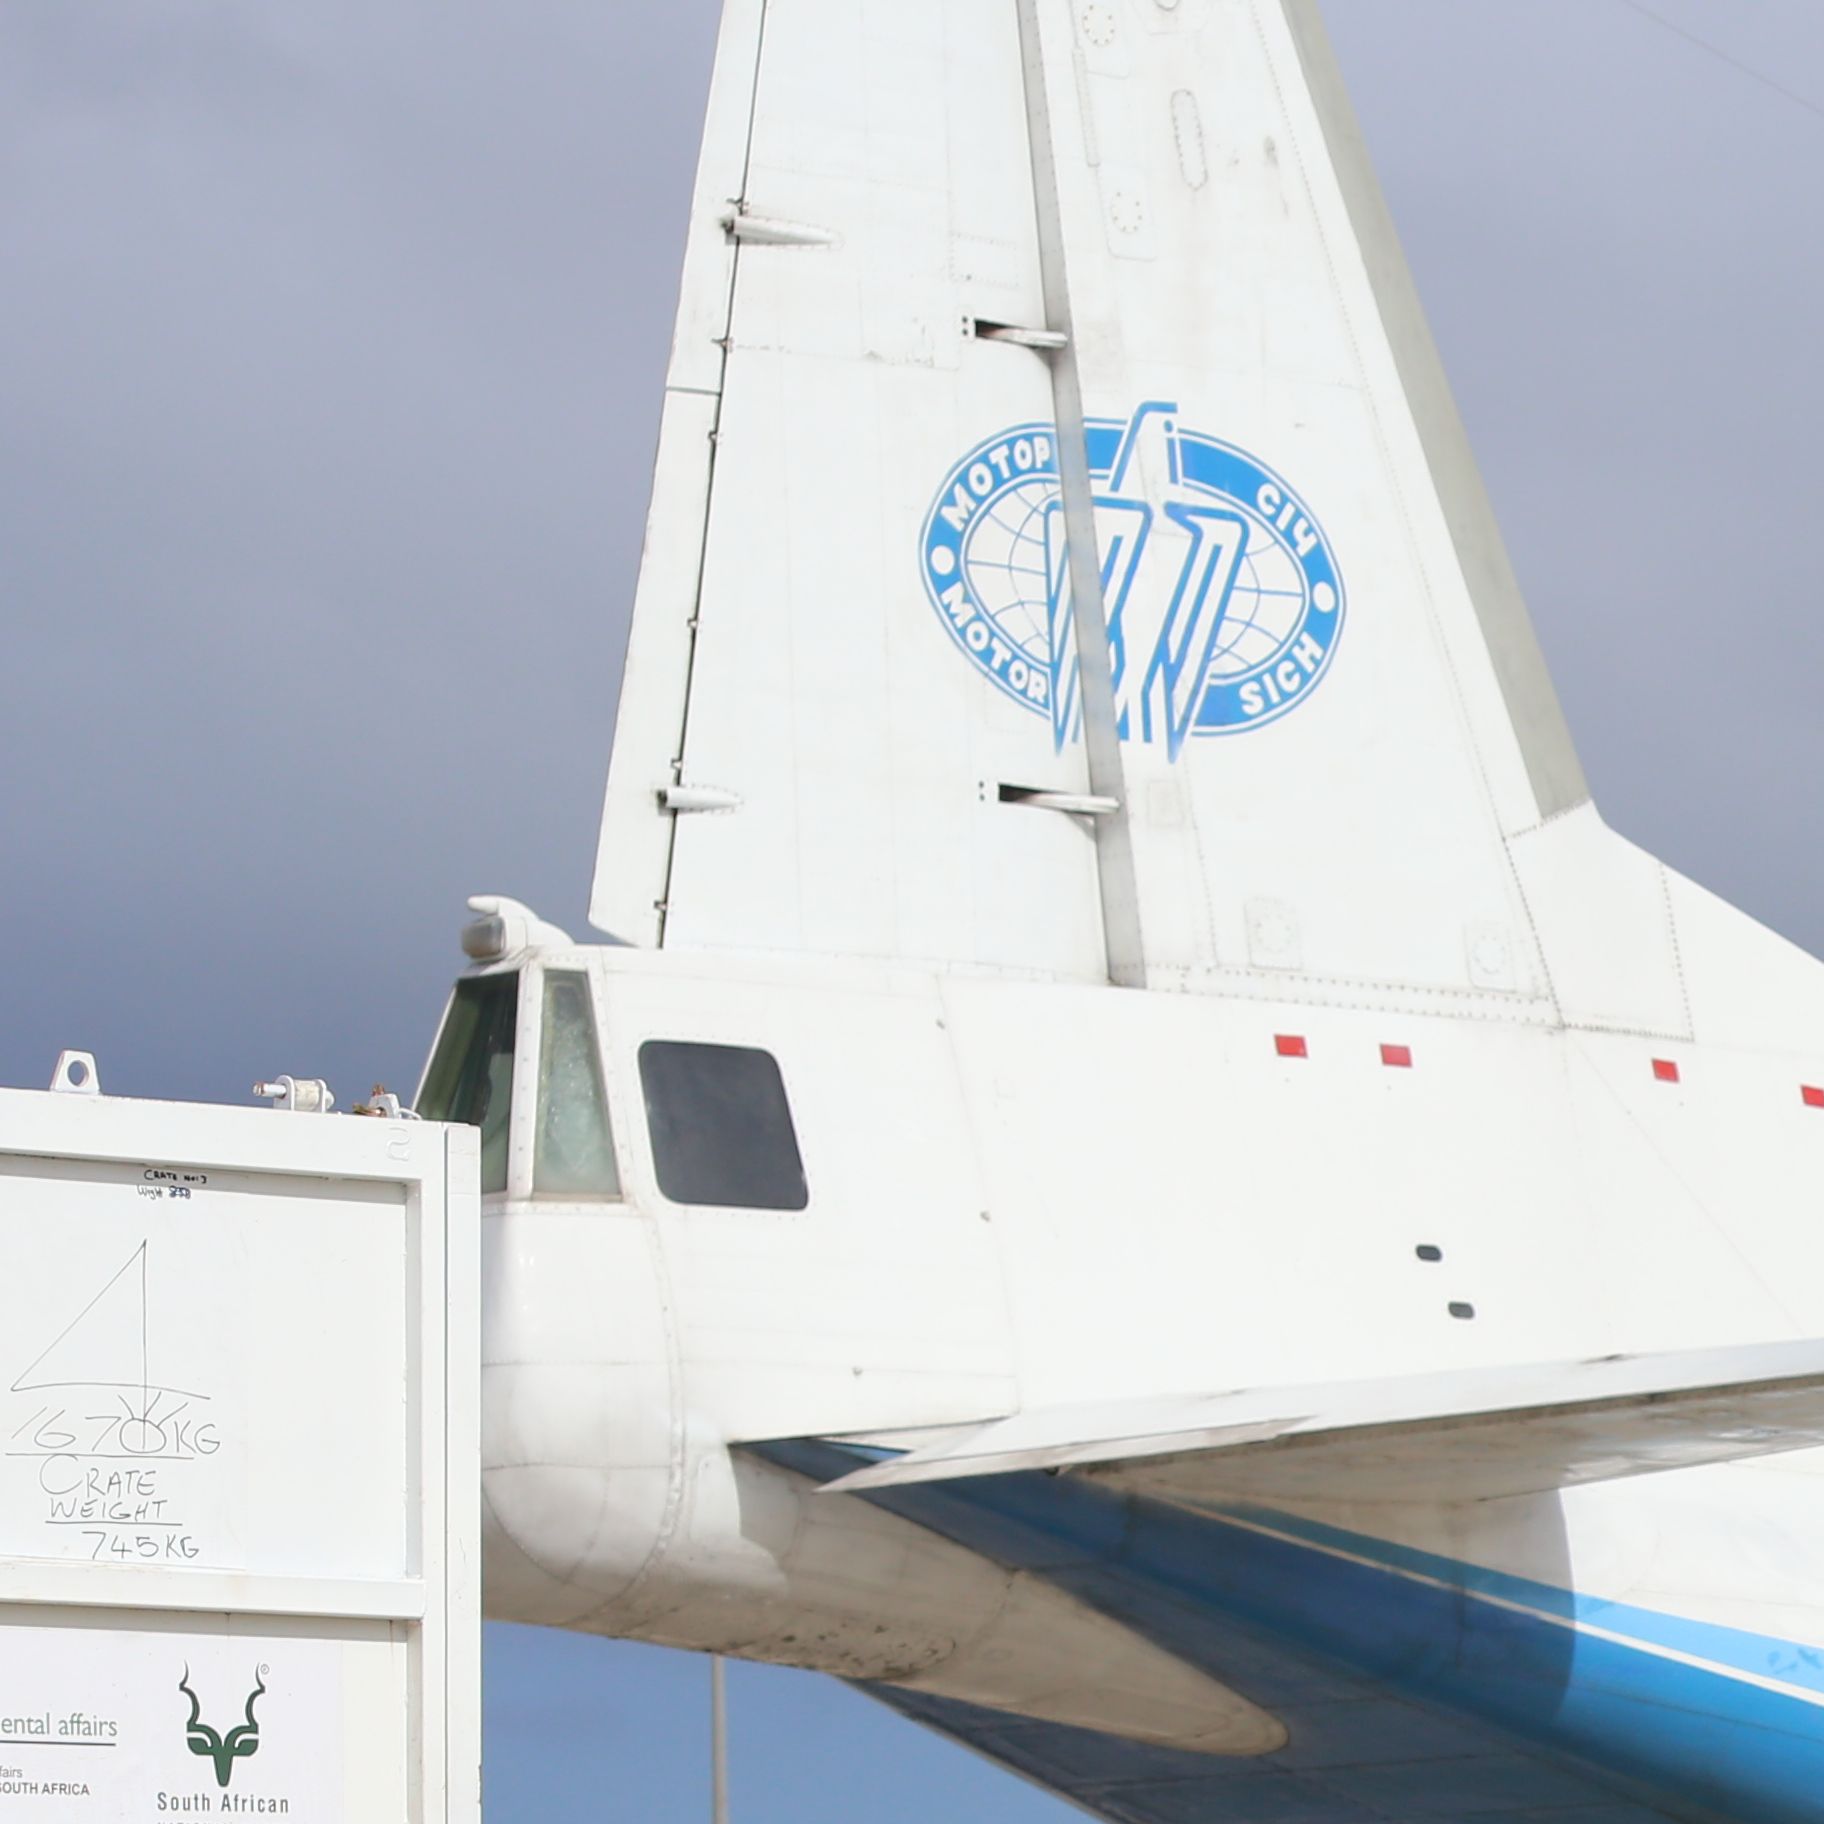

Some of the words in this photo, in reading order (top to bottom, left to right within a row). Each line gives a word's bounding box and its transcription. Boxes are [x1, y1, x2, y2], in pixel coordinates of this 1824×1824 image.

[940, 580, 1050, 705] MOTOR
[1240, 629, 1325, 717] SICH
[39, 1454, 157, 1498] CRATE
[50, 1498, 168, 1521] WEIGHT
[58, 1713, 118, 1737] affairs
[0, 1782, 39, 1795] OUTH
[41, 1783, 90, 1796] AFRICA
[157, 1792, 211, 1812] South
[221, 1793, 289, 1814] African
